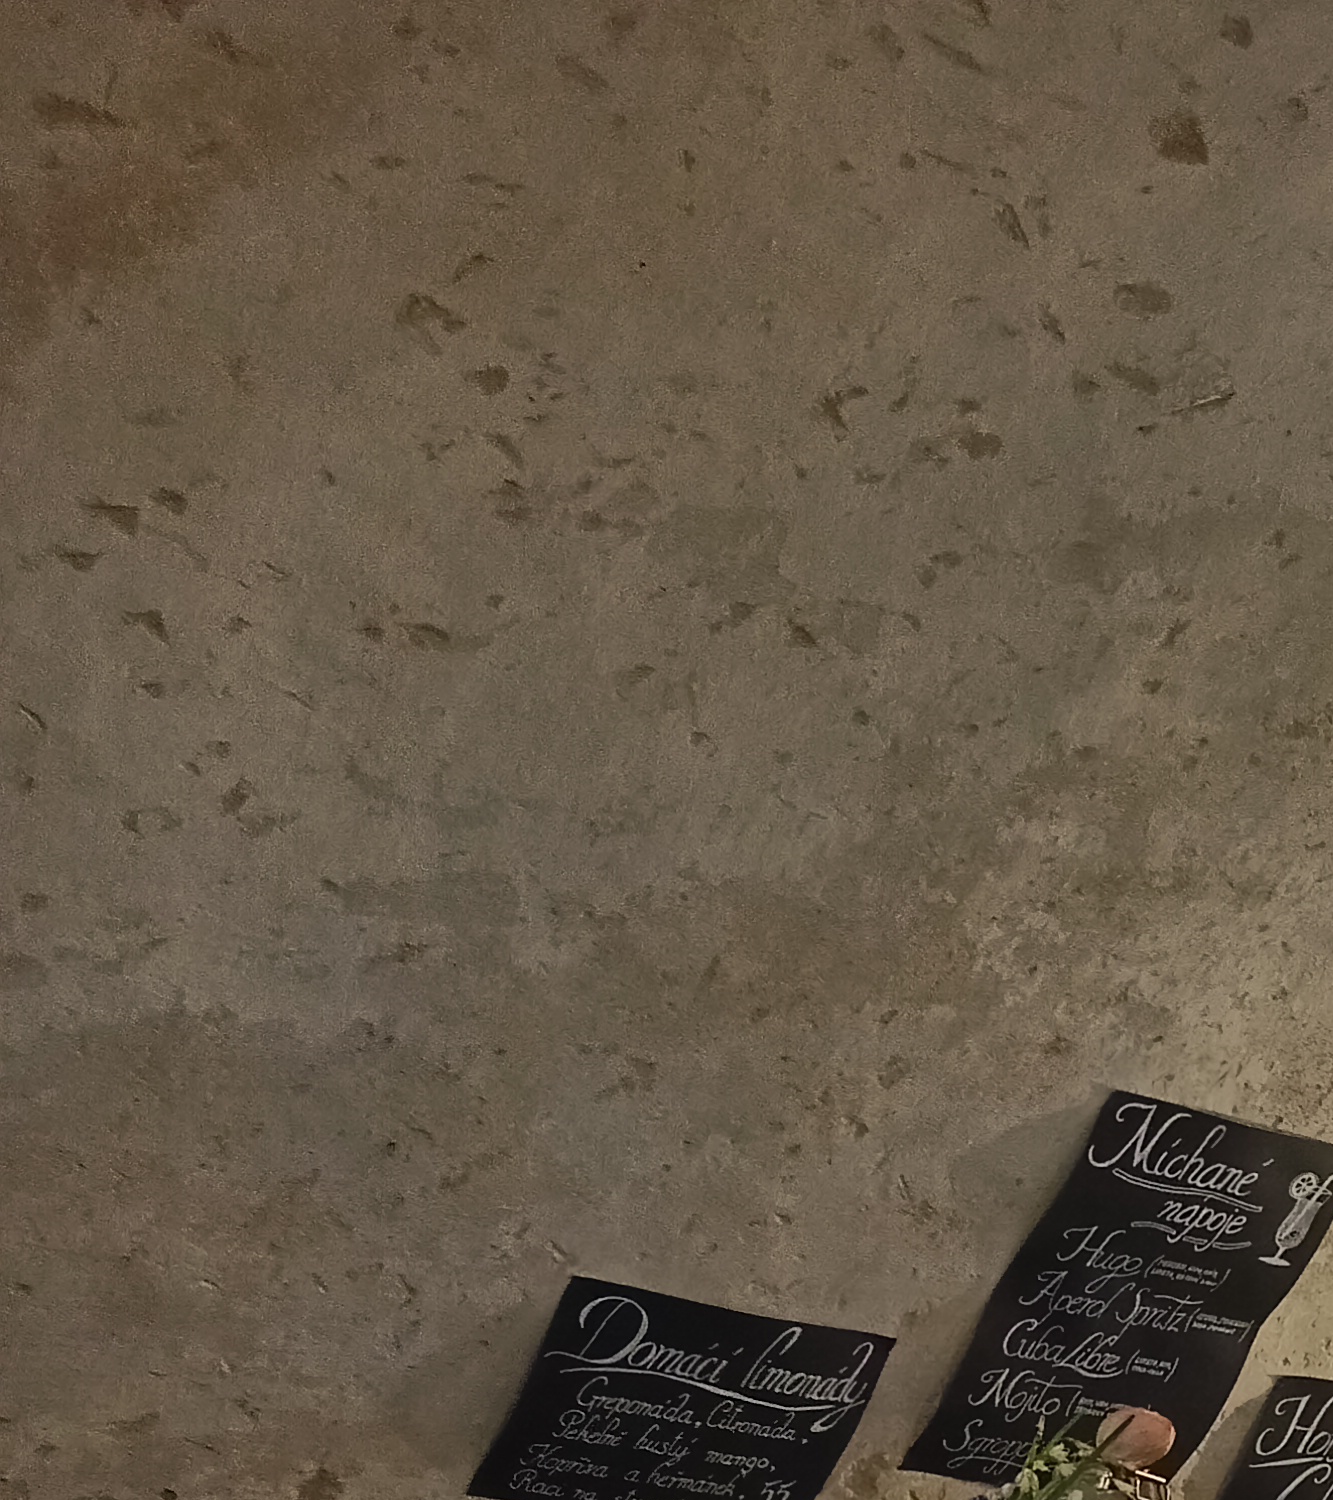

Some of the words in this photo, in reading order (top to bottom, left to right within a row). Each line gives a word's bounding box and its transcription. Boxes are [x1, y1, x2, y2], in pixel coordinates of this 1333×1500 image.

[1088, 1102, 1275, 1197] Míchané
[1056, 1225, 1144, 1294] Hugo
[1019, 1270, 1136, 1328] Aperol
[1108, 1288, 1203, 1342] Spritz
[544, 1296, 742, 1386] Domácí
[741, 1326, 874, 1433] limonády
[1002, 1318, 1066, 1364] Cuba
[1052, 1331, 1124, 1378] Libre
[968, 1368, 1082, 1422] Mojito
[519, 1443, 609, 1480] Kopřiva
[623, 1469, 640, 1483] a
[552, 1409, 627, 1448] Pekelně
[634, 1424, 699, 1466] hustý
